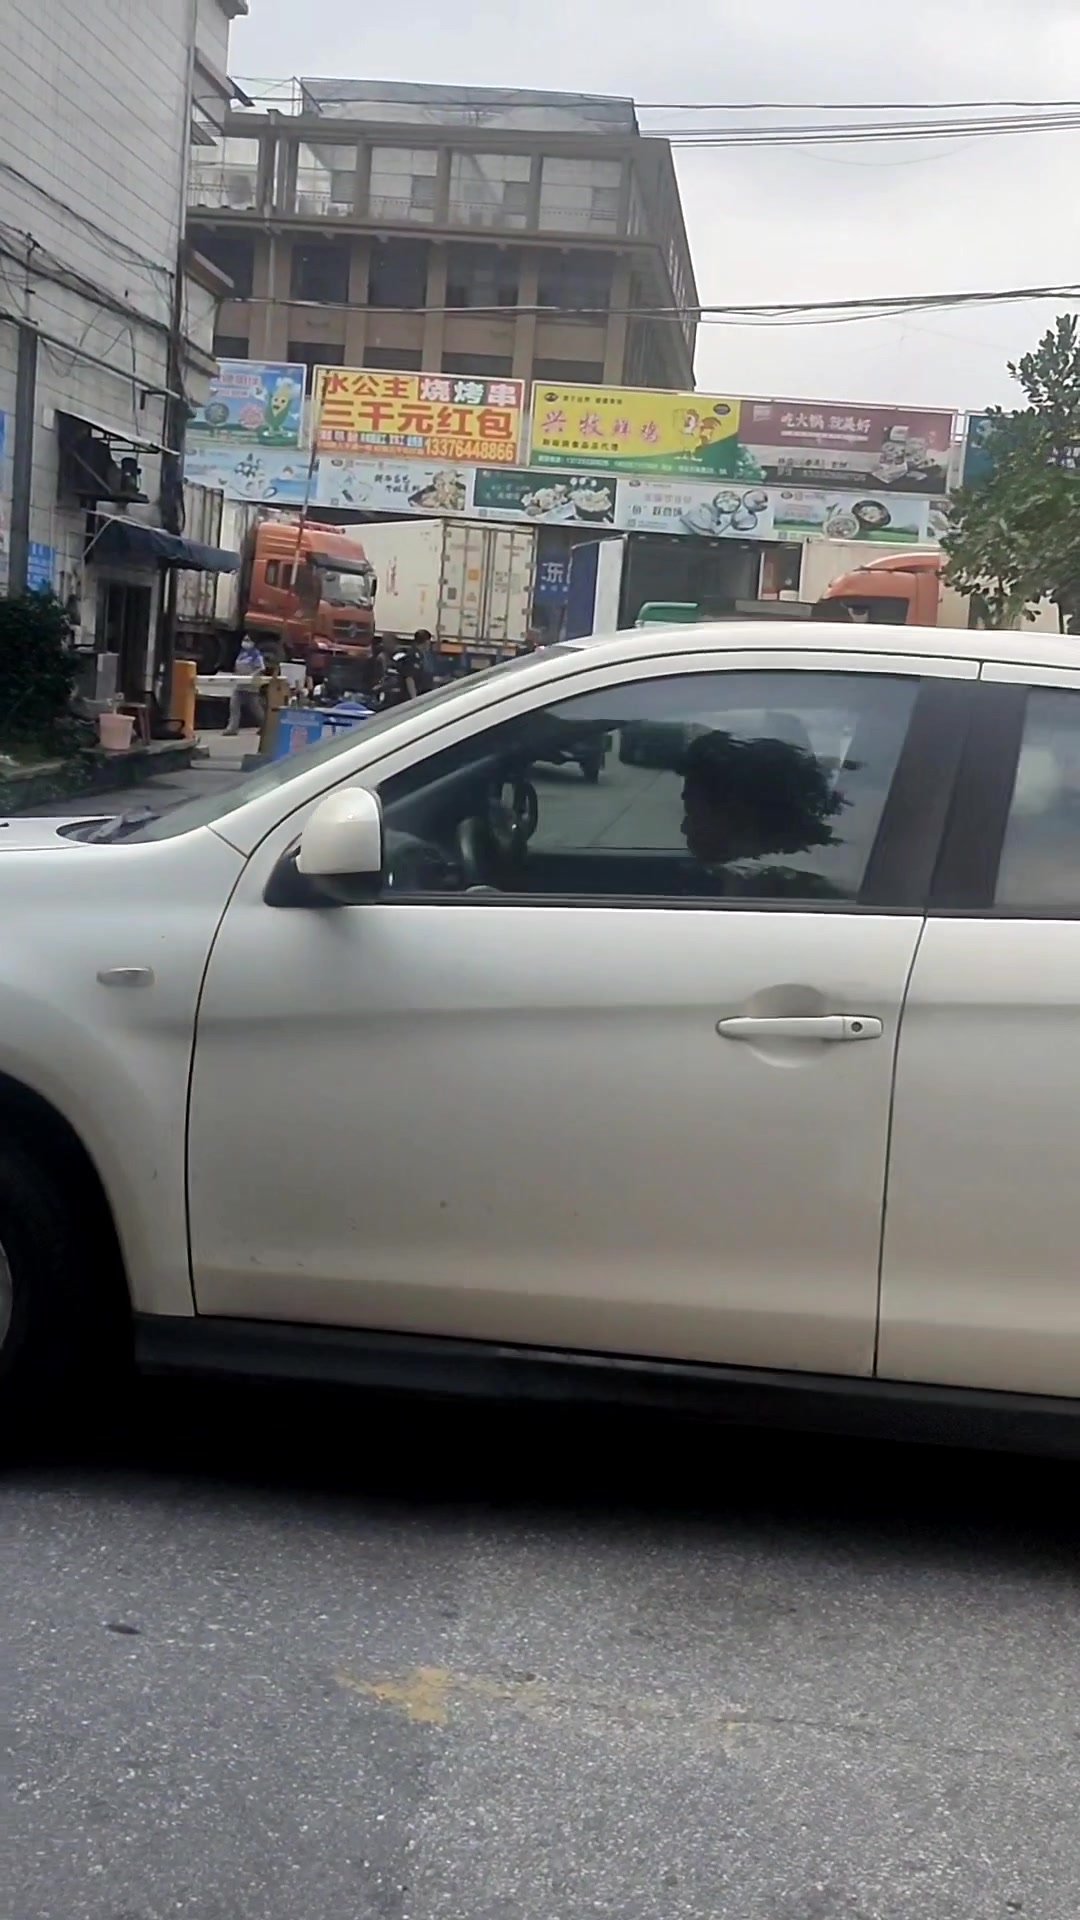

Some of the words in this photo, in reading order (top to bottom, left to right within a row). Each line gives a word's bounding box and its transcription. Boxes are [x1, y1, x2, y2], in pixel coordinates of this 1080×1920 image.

[420, 378, 517, 406] 烧烤串
[320, 400, 513, 439] 三千元红包
[425, 438, 514, 460] 13376448866
